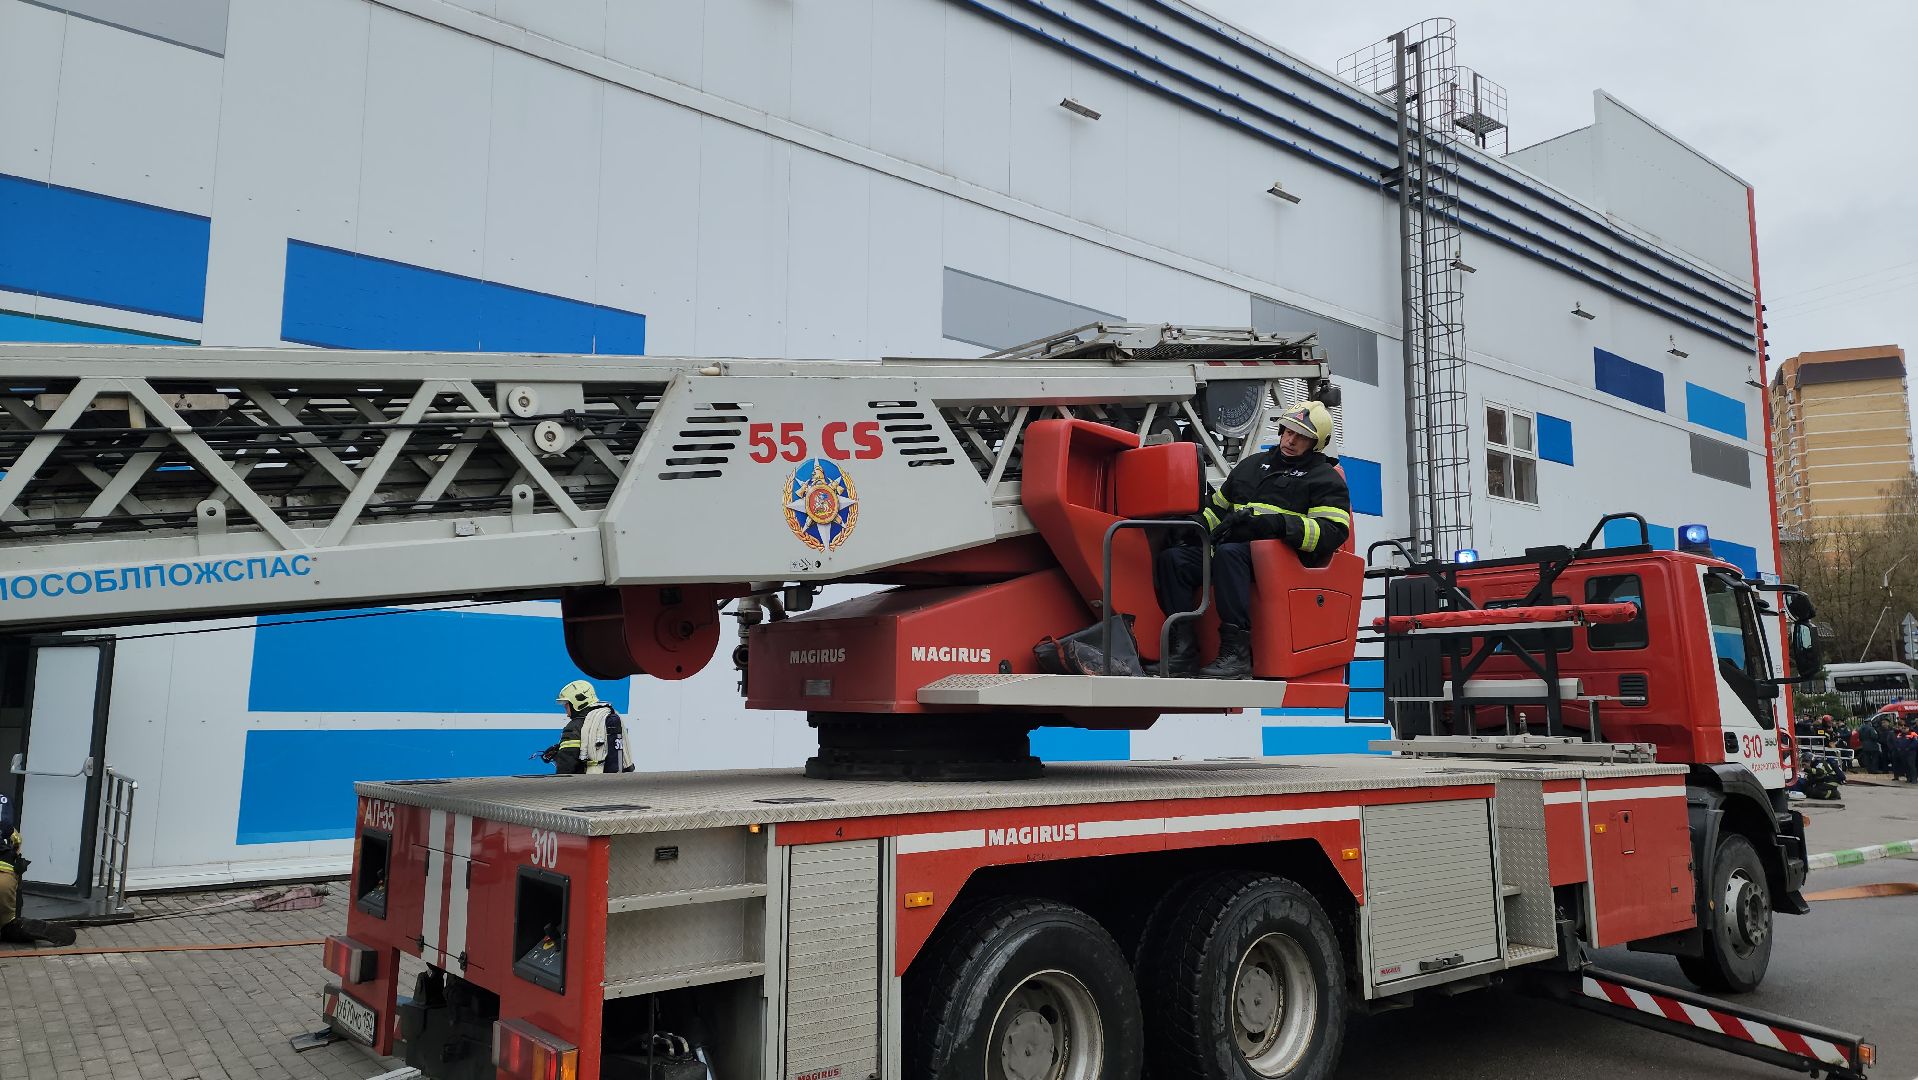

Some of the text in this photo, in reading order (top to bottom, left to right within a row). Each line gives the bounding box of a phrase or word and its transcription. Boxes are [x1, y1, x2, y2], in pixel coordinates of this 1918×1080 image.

[750, 421, 883, 463] 55 CS
[790, 647, 846, 664] MAGIRUS
[911, 646, 991, 663] MAGIRUS
[1743, 734, 1763, 758] 310
[835, 826, 843, 838] 4
[988, 823, 1076, 847] MAGIRUS
[530, 828, 558, 869] 310
[797, 1067, 840, 1080] MAGIRUS
